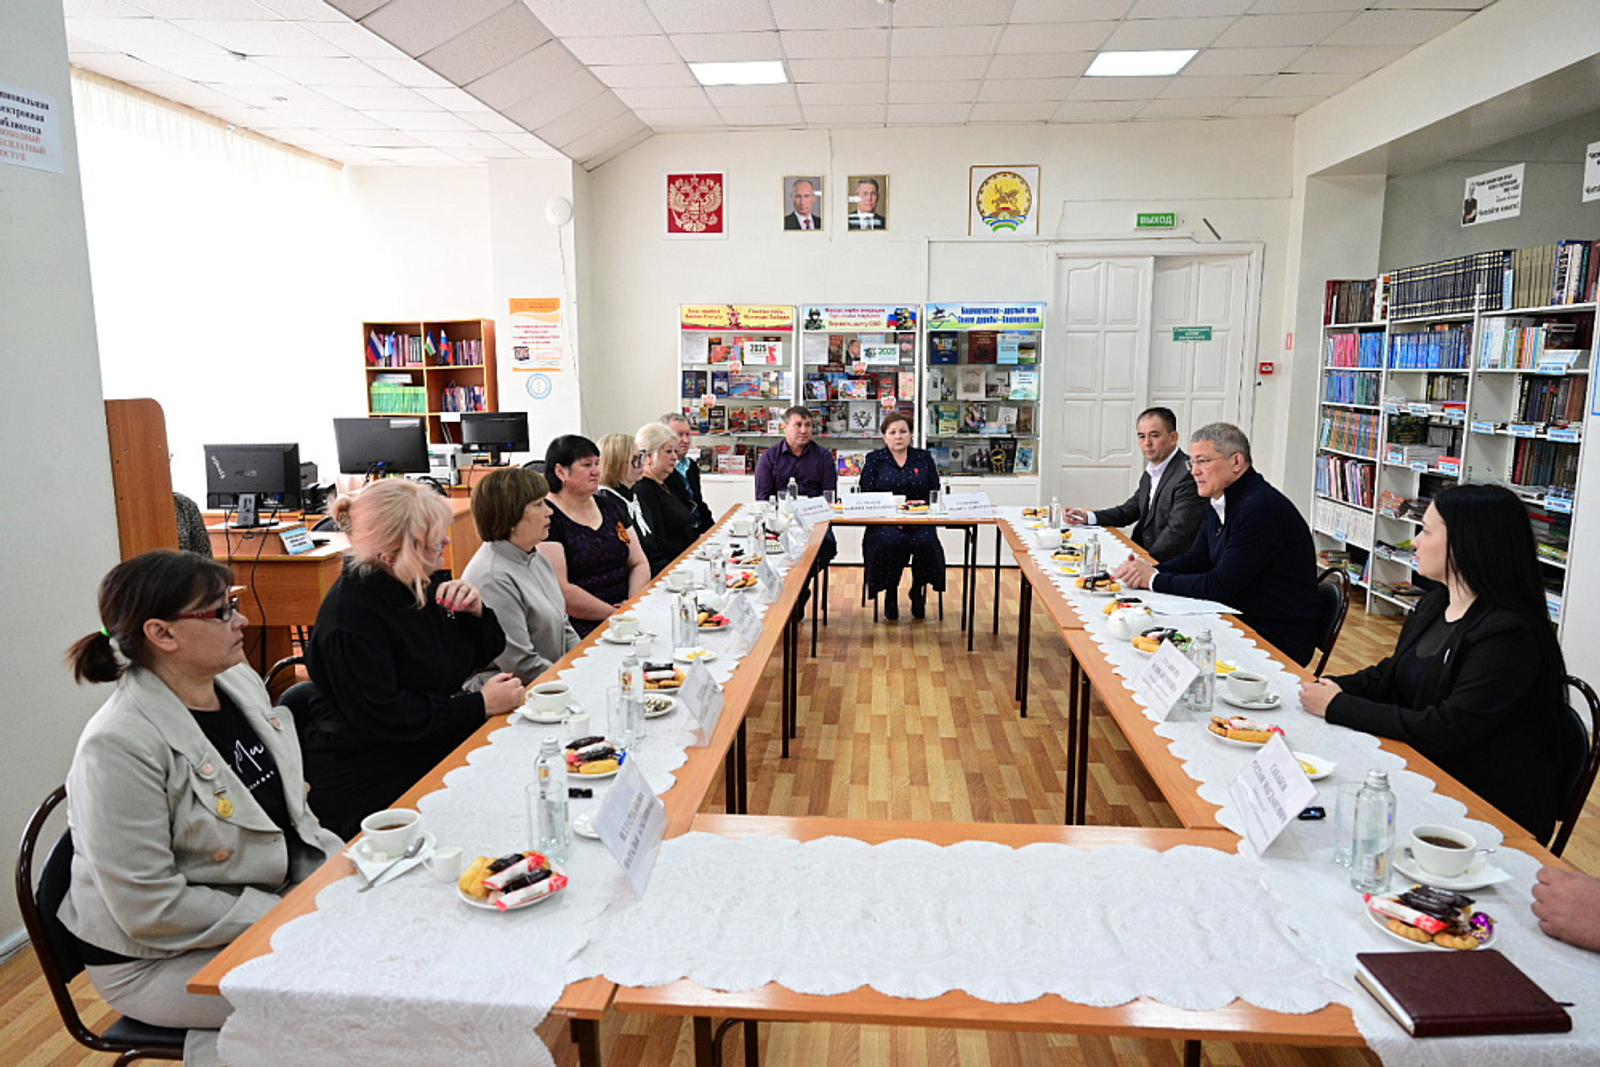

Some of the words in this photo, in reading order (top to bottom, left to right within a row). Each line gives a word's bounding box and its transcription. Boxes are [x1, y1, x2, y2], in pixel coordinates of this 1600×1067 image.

[1140, 216, 1173, 225] ВЫХОД
[749, 344, 768, 353] 2025
[877, 347, 898, 356] 2025
